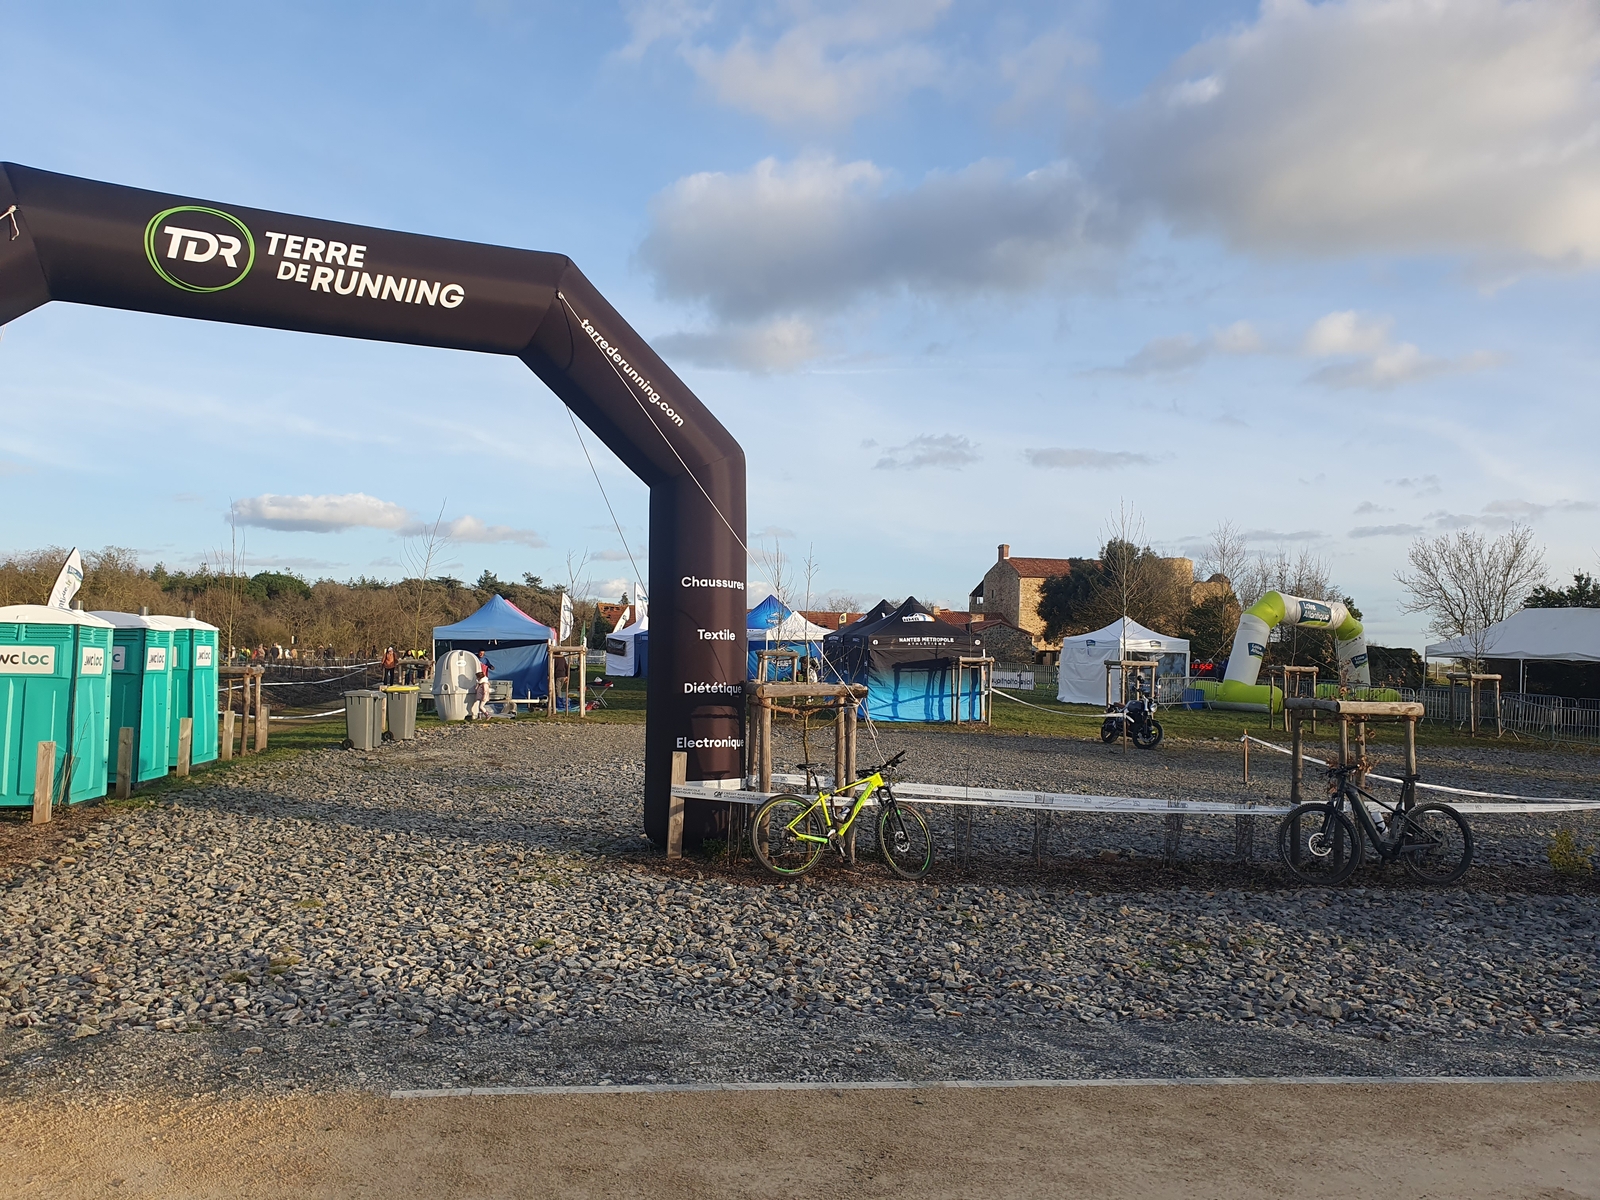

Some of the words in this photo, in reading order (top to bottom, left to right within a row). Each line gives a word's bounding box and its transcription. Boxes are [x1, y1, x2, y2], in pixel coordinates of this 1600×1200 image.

[163, 225, 242, 268] TDR
[264, 231, 367, 268] TERRE
[276, 260, 311, 283] DE
[309, 266, 465, 309] RUNNING
[580, 318, 684, 427] terrederunning.com
[681, 575, 744, 590] Chaussures
[697, 628, 736, 641] Textile
[684, 681, 742, 696] Diététique
[676, 735, 744, 750] Electronique
